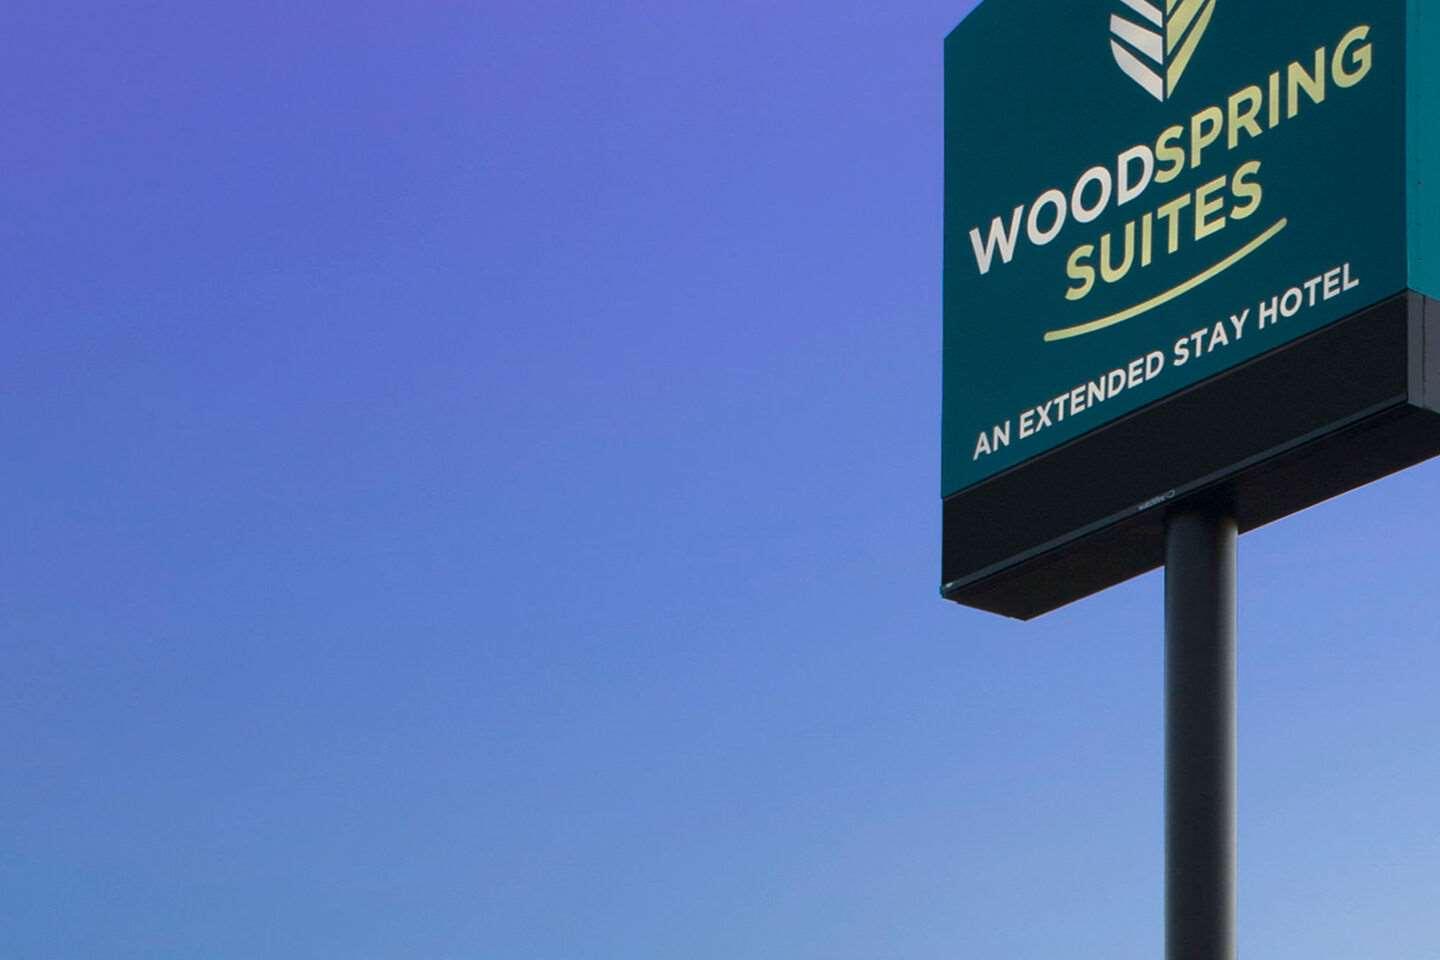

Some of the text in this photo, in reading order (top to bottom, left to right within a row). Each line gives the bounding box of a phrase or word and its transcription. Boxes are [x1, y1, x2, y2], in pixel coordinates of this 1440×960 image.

[968, 24, 1373, 275] WOODSPRING
[1064, 160, 1263, 301] SUITES
[972, 261, 1361, 461] AN EXTENDED STAY HOTEL
